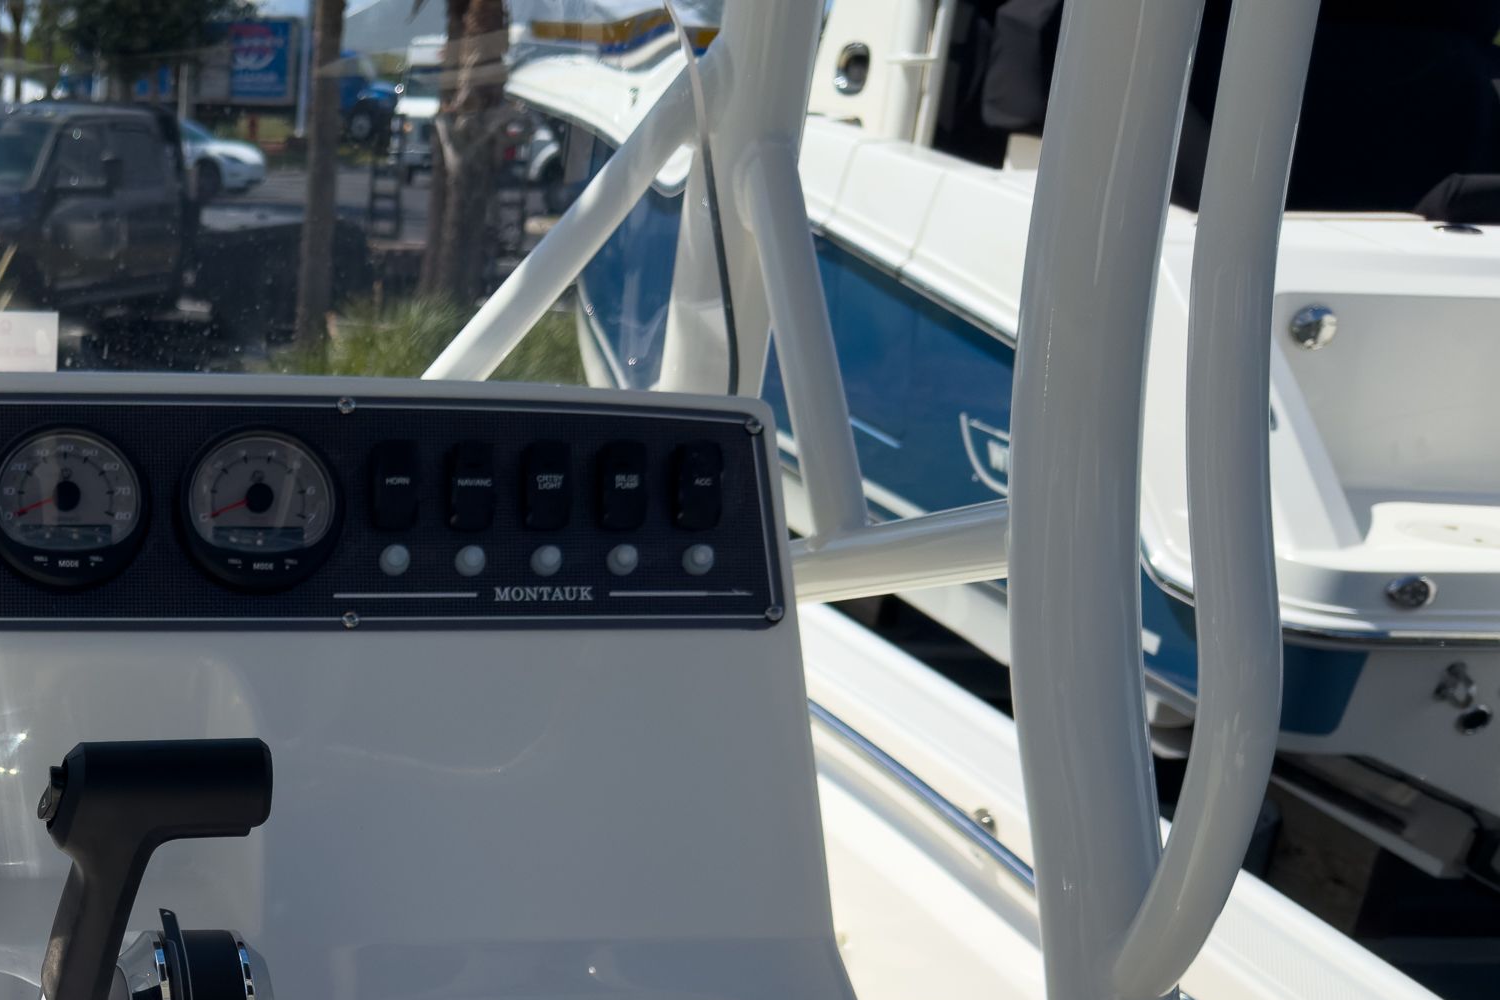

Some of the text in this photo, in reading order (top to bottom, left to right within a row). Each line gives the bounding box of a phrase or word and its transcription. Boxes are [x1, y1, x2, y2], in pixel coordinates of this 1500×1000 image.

[385, 476, 410, 486] HORN
[538, 481, 562, 491] LIGHT
[58, 559, 80, 568] MODE
[252, 561, 274, 570] MODE
[494, 586, 593, 602] MONTAUK
